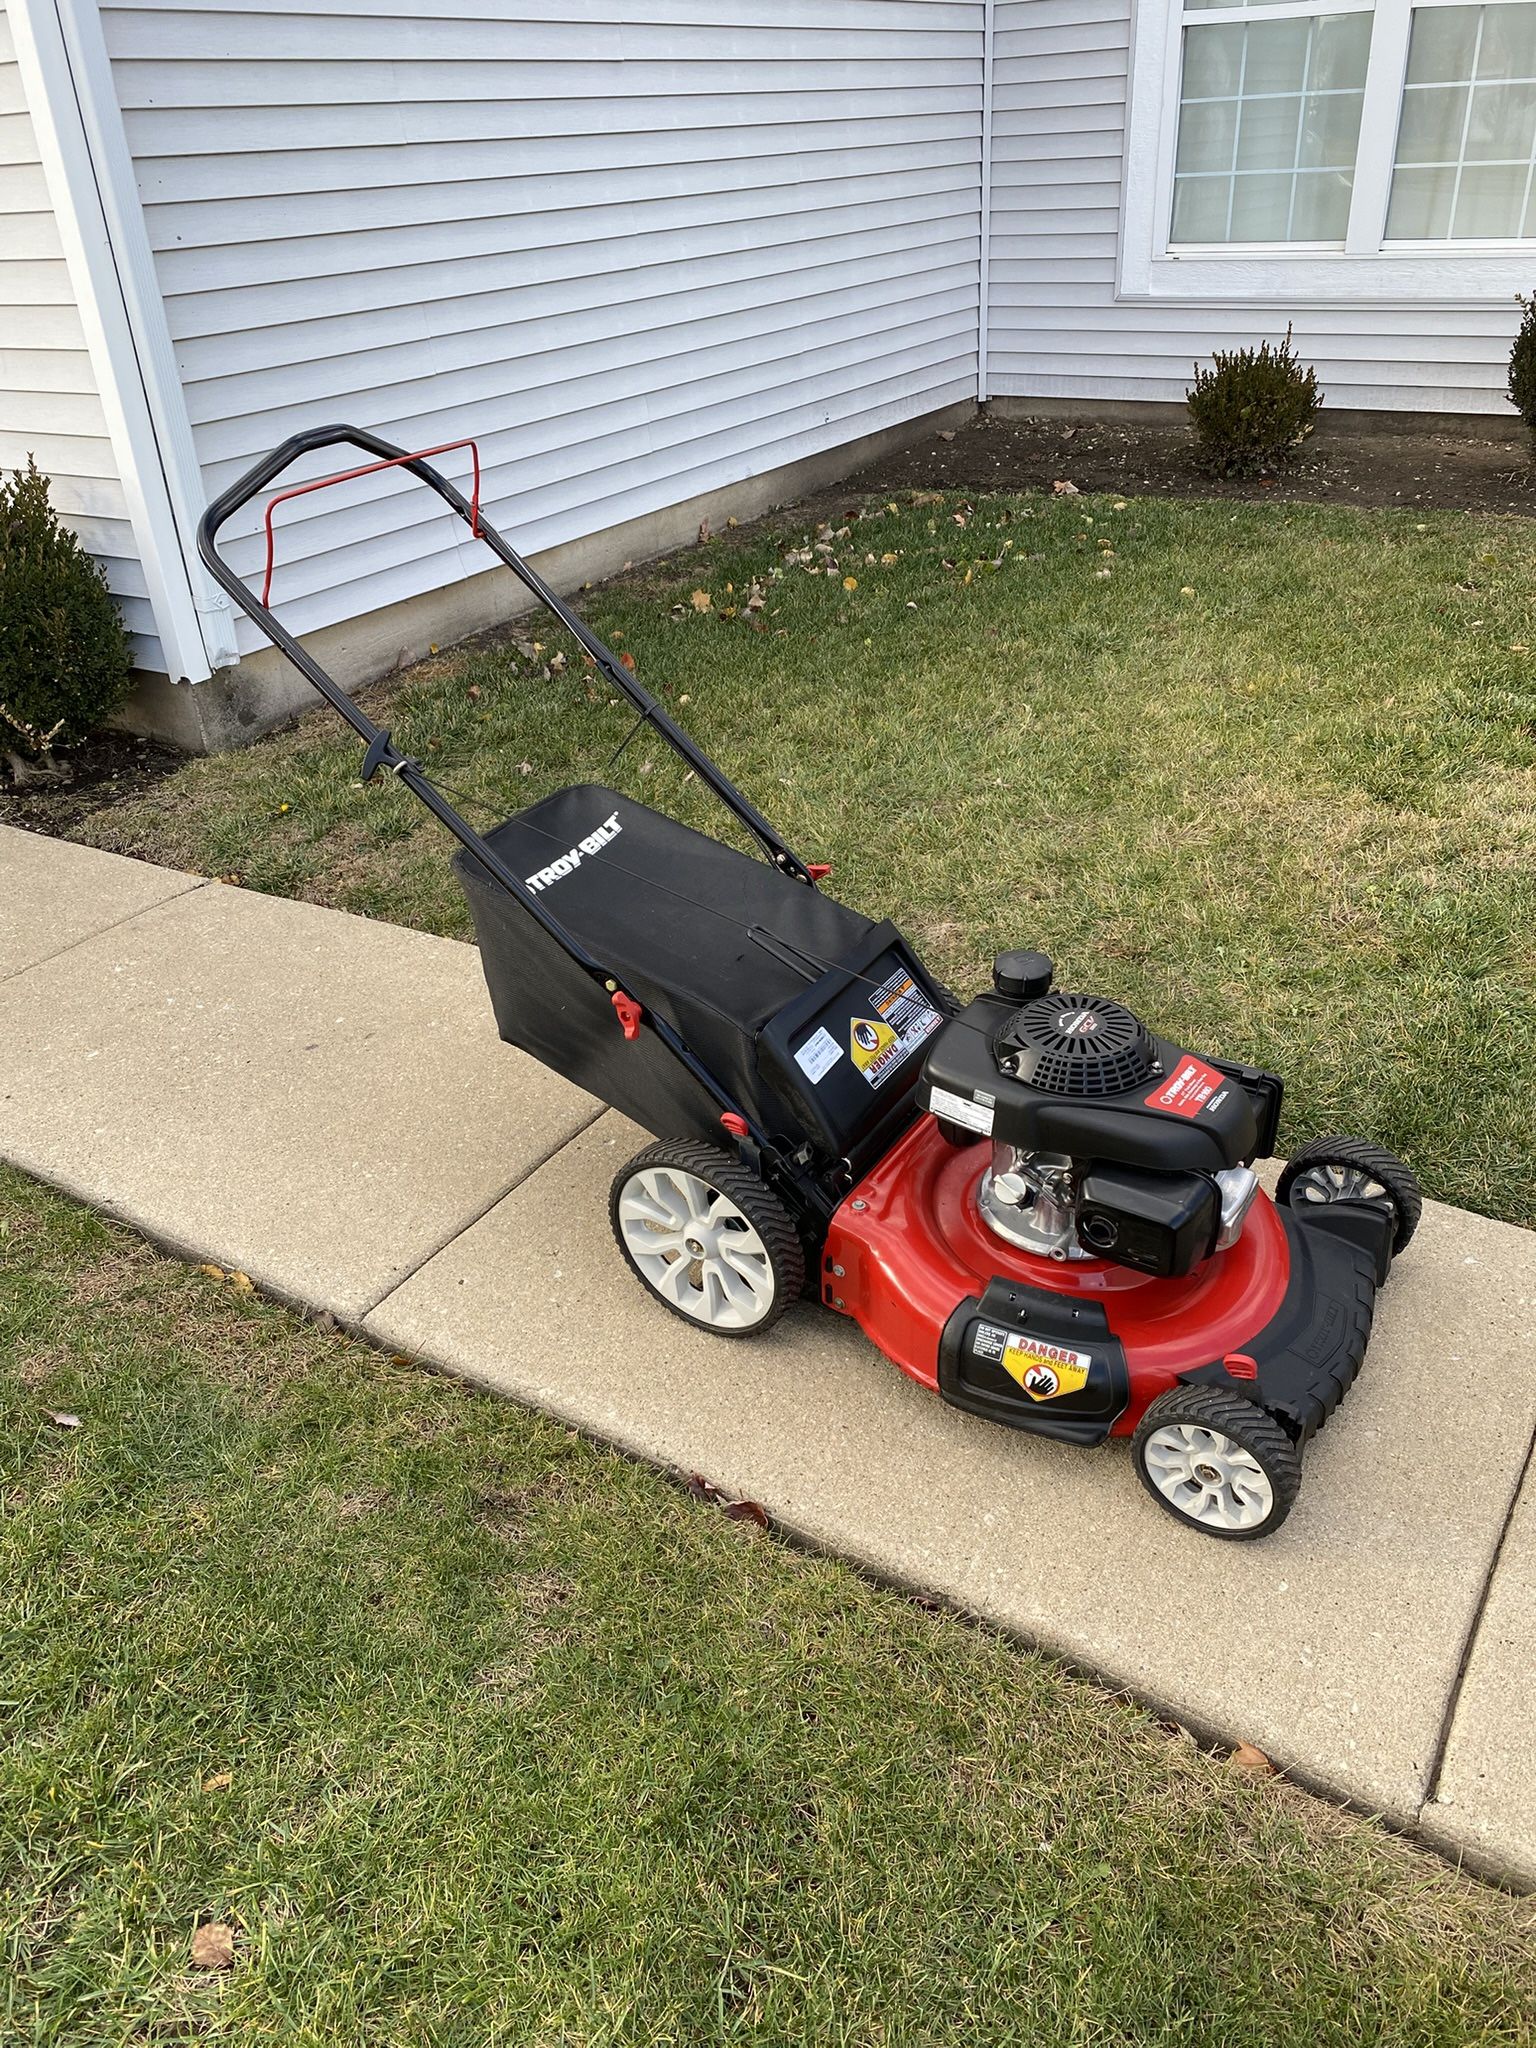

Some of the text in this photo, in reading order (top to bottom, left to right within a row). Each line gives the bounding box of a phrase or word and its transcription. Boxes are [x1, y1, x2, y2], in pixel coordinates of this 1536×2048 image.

[525, 811, 623, 891] TROY-BILT
[1065, 1011, 1090, 1034] HONDA
[1079, 1016, 1095, 1033] GCV
[869, 1044, 899, 1074] DANGER
[1208, 1090, 1230, 1112] HONDA
[1009, 1348, 1021, 1357] KEEP
[1023, 1352, 1043, 1363] HANDS
[1054, 1359, 1068, 1370] FEET
[1069, 1364, 1086, 1375] AWAY
[1018, 1338, 1079, 1365] DANGER
